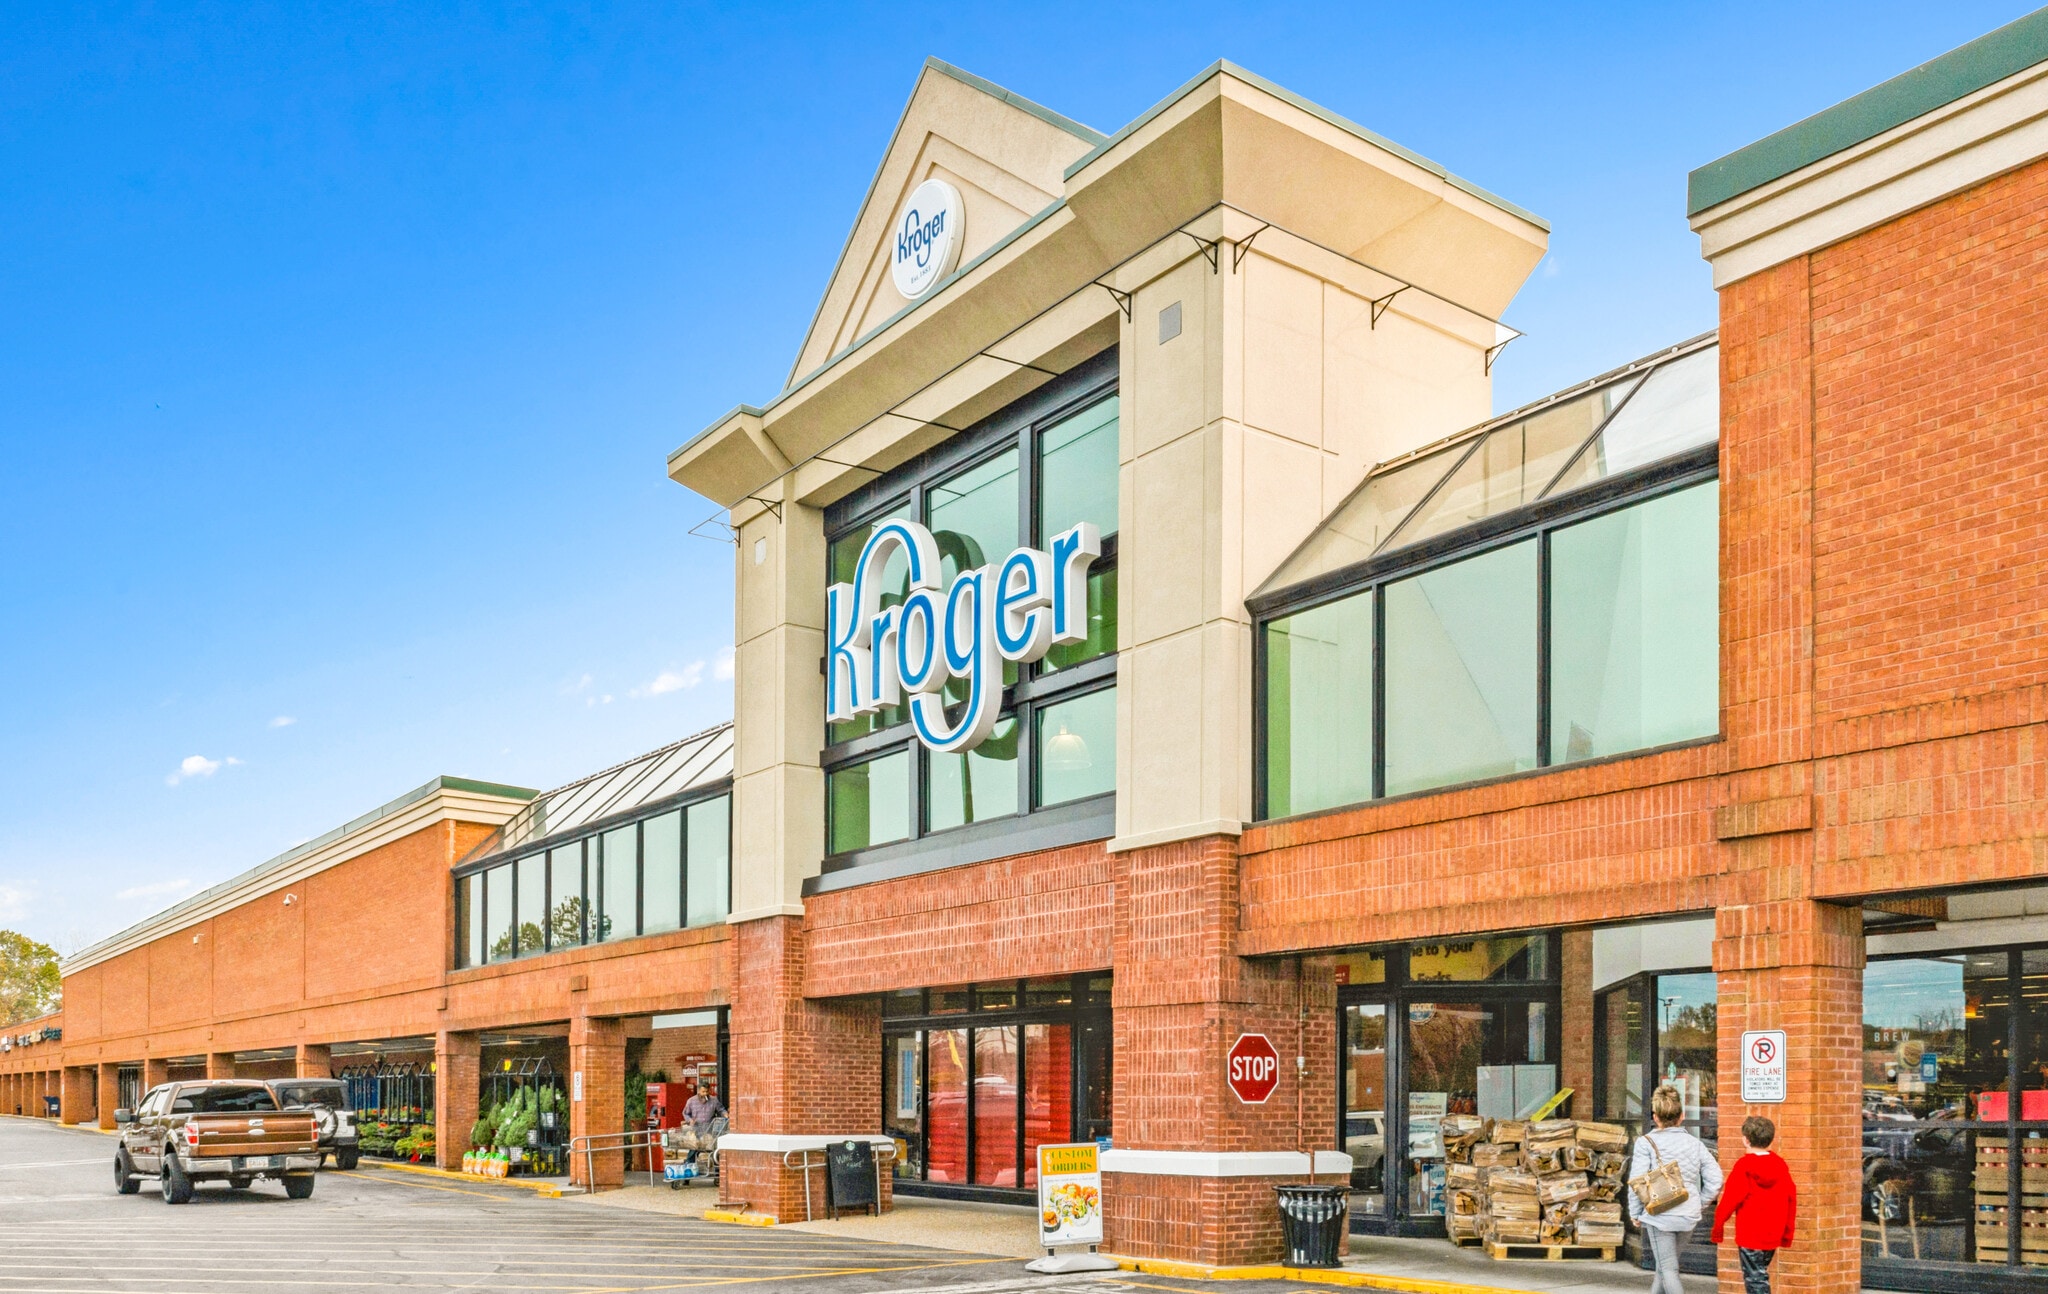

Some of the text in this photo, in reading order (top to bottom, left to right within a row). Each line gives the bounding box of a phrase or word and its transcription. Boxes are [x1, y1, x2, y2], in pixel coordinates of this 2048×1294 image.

[898, 209, 946, 267] Kroger
[827, 518, 1097, 752] Kroger
[1426, 945, 1439, 956] to
[1444, 942, 1474, 958] your
[1874, 1032, 1910, 1042] BREW
[1232, 1056, 1275, 1081] STOP
[1745, 1067, 1782, 1076] FIRE LANE
[1051, 1149, 1092, 1159] CUSTOM
[1052, 1162, 1092, 1172] ORDERS
